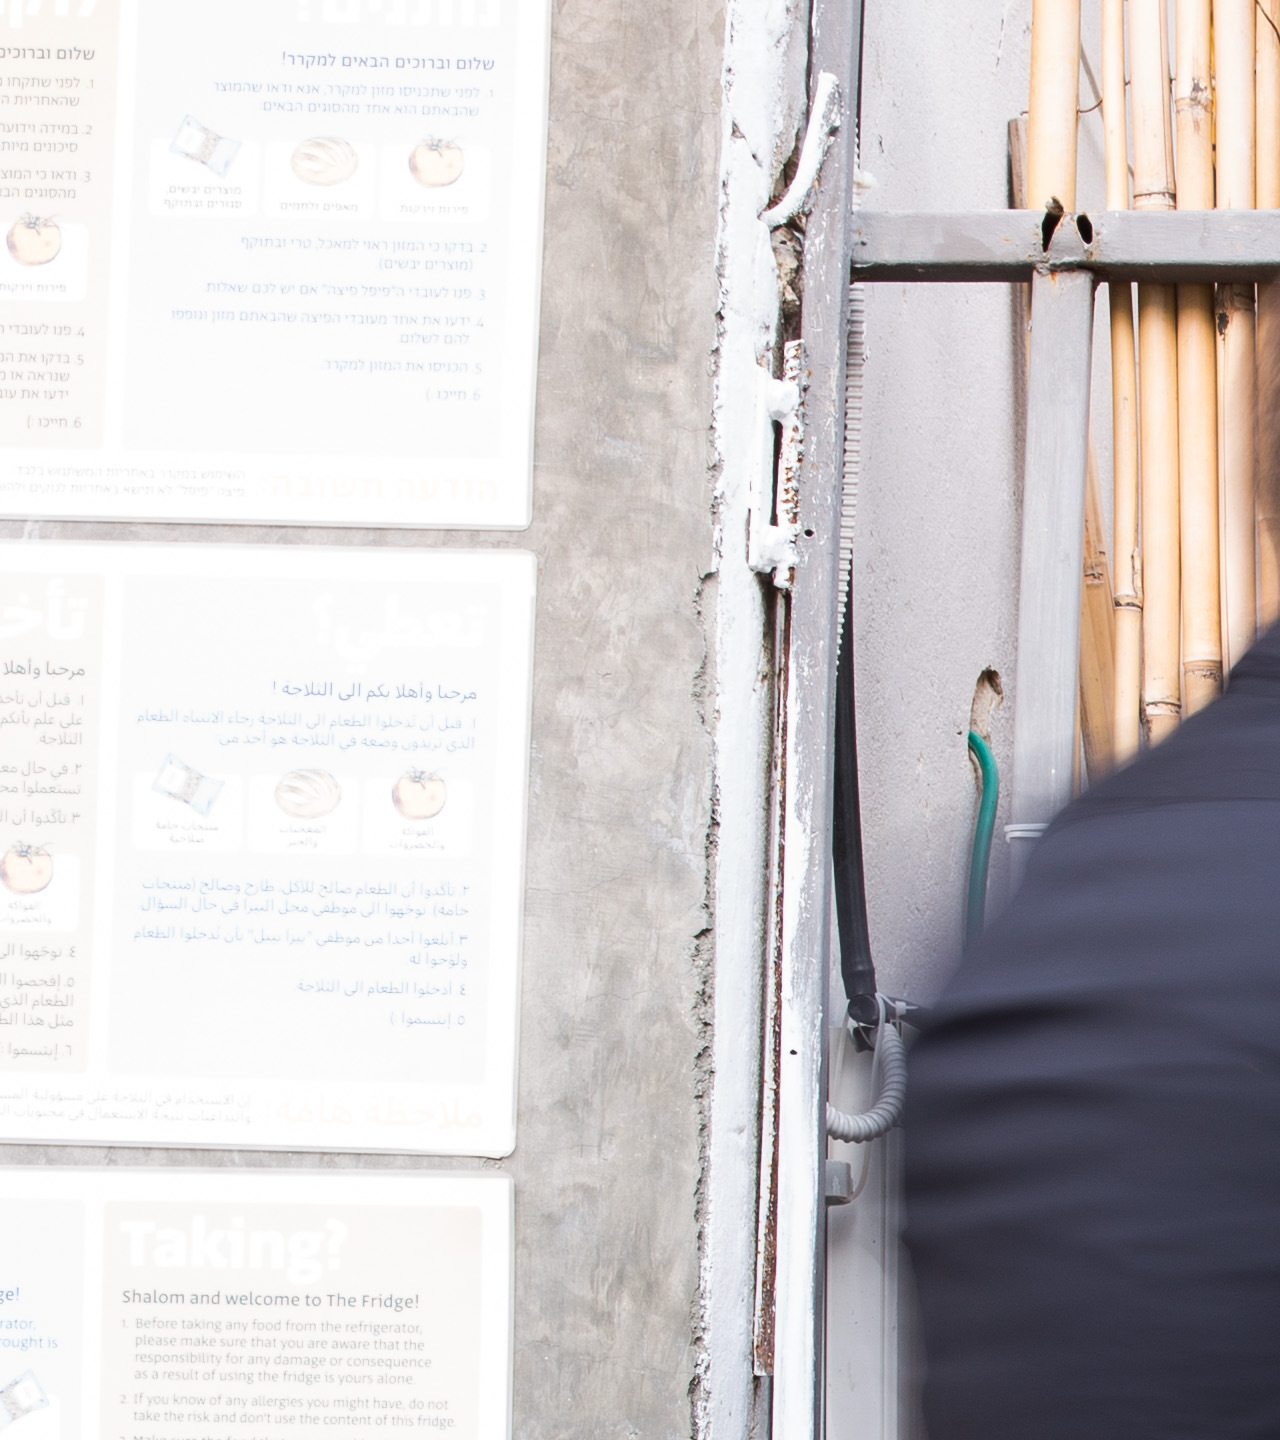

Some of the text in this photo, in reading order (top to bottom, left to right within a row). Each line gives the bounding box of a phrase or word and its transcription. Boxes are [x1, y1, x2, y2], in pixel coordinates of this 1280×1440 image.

[119, 1215, 349, 1285] Taking?
[122, 1289, 419, 1313] Shalom and welcome to The Fridge!
[136, 1317, 178, 1329] Before
[181, 1319, 222, 1333] taking
[225, 1321, 248, 1332] any
[252, 1319, 281, 1331] food
[285, 1319, 317, 1332] from
[320, 1320, 342, 1333] the
[135, 1334, 425, 1351] please make sure that you are aware that the
[135, 1352, 432, 1370] responsibility for any damage or consequence
[134, 1370, 148, 1380] as
[151, 1370, 159, 1380] a
[162, 1369, 199, 1381] result
[202, 1369, 215, 1381] of
[219, 1372, 254, 1385] using
[258, 1370, 279, 1382] the
[283, 1370, 321, 1386] fridge
[324, 1374, 335, 1383] is
[338, 1374, 373, 1386] yours
[134, 1392, 143, 1404] If
[147, 1396, 169, 1407] you
[173, 1393, 206, 1406] know
[209, 1394, 222, 1406] of
[225, 1397, 248, 1409] any
[251, 1396, 304, 1410] allergies
[307, 1398, 329, 1410] you
[333, 1397, 369, 1412] might
[408, 1398, 425, 1410] do
[428, 1400, 448, 1411] not
[133, 1410, 161, 1422] take
[164, 1410, 184, 1422] the
[187, 1411, 210, 1423] risk
[213, 1412, 236, 1423] and
[239, 1412, 271, 1423] don't
[274, 1415, 296, 1425] use
[300, 1413, 320, 1425] the
[323, 1415, 372, 1425] content
[375, 1414, 387, 1426] of
[391, 1415, 414, 1427] this
